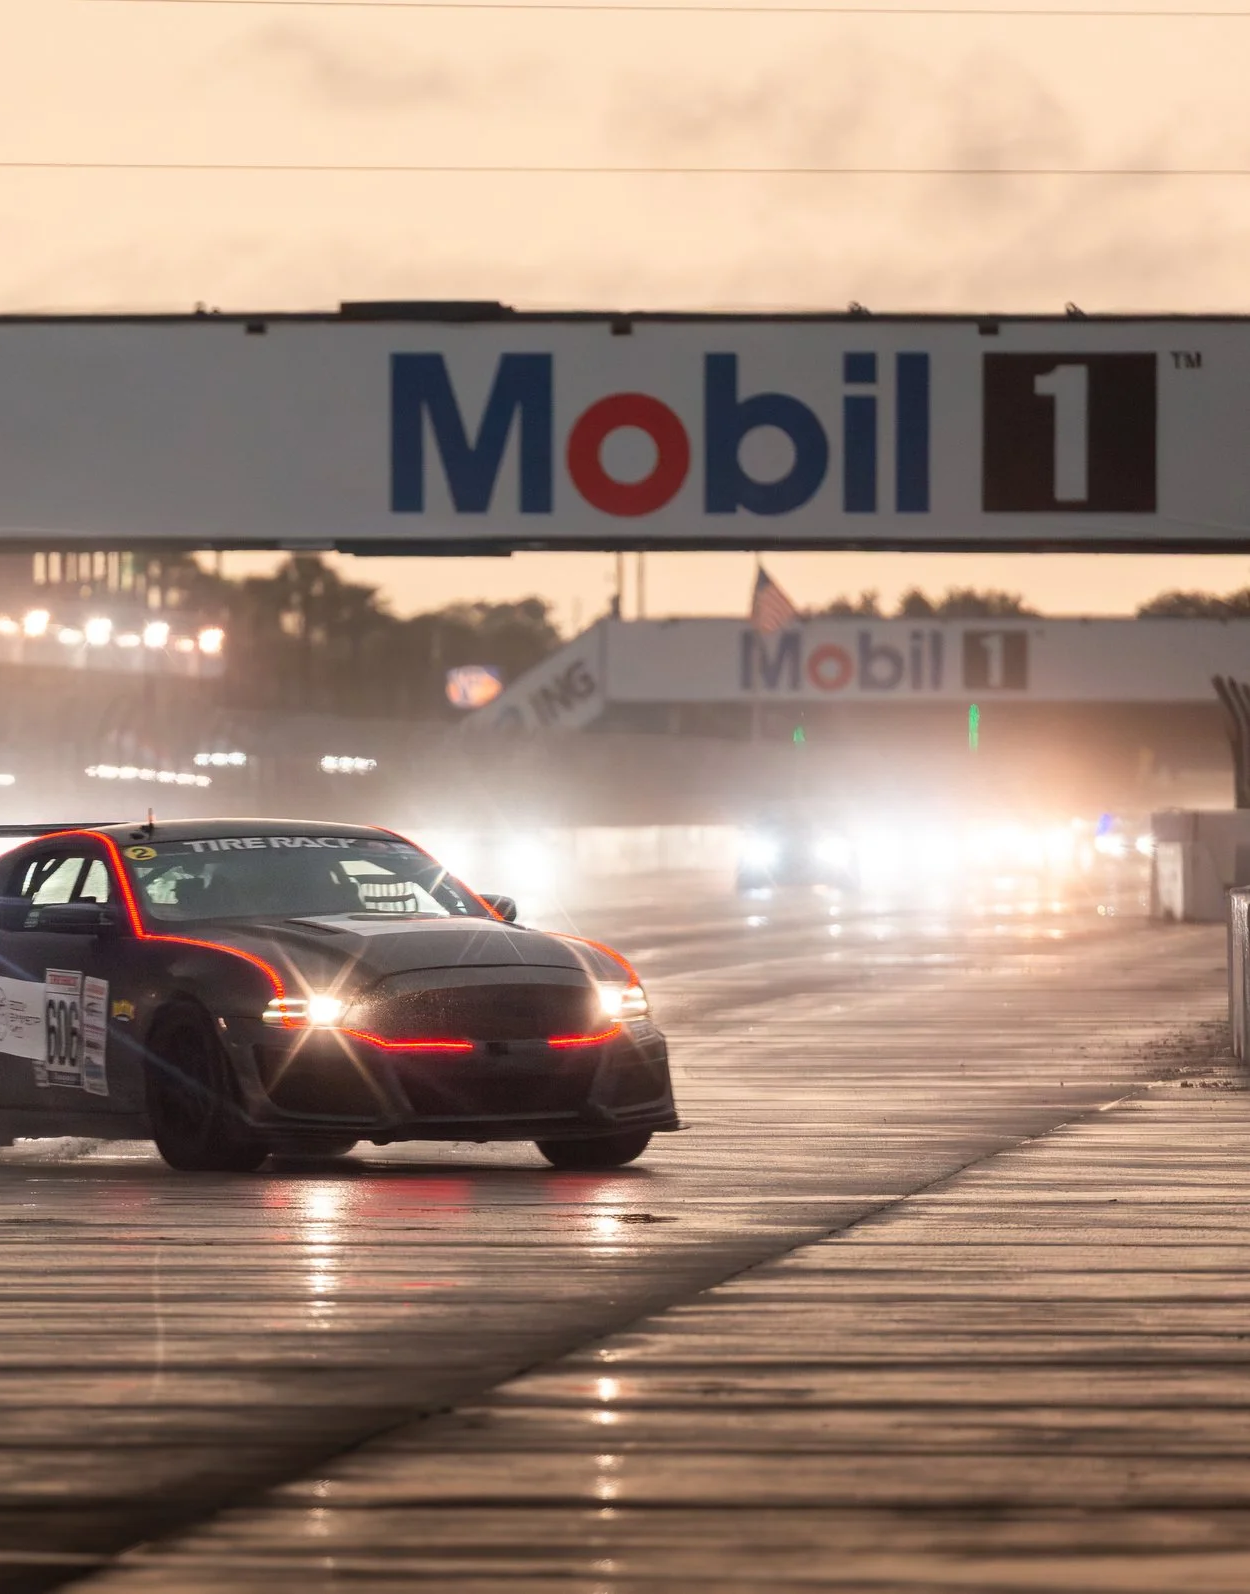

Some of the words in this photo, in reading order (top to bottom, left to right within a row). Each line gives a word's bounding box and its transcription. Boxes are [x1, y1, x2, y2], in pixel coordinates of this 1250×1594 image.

[389, 352, 931, 518] Mobil
[1033, 364, 1088, 502] 1
[1170, 350, 1202, 369] TM
[739, 629, 944, 692] Mobil
[979, 635, 1003, 687] 1
[184, 837, 265, 853] TIRE
